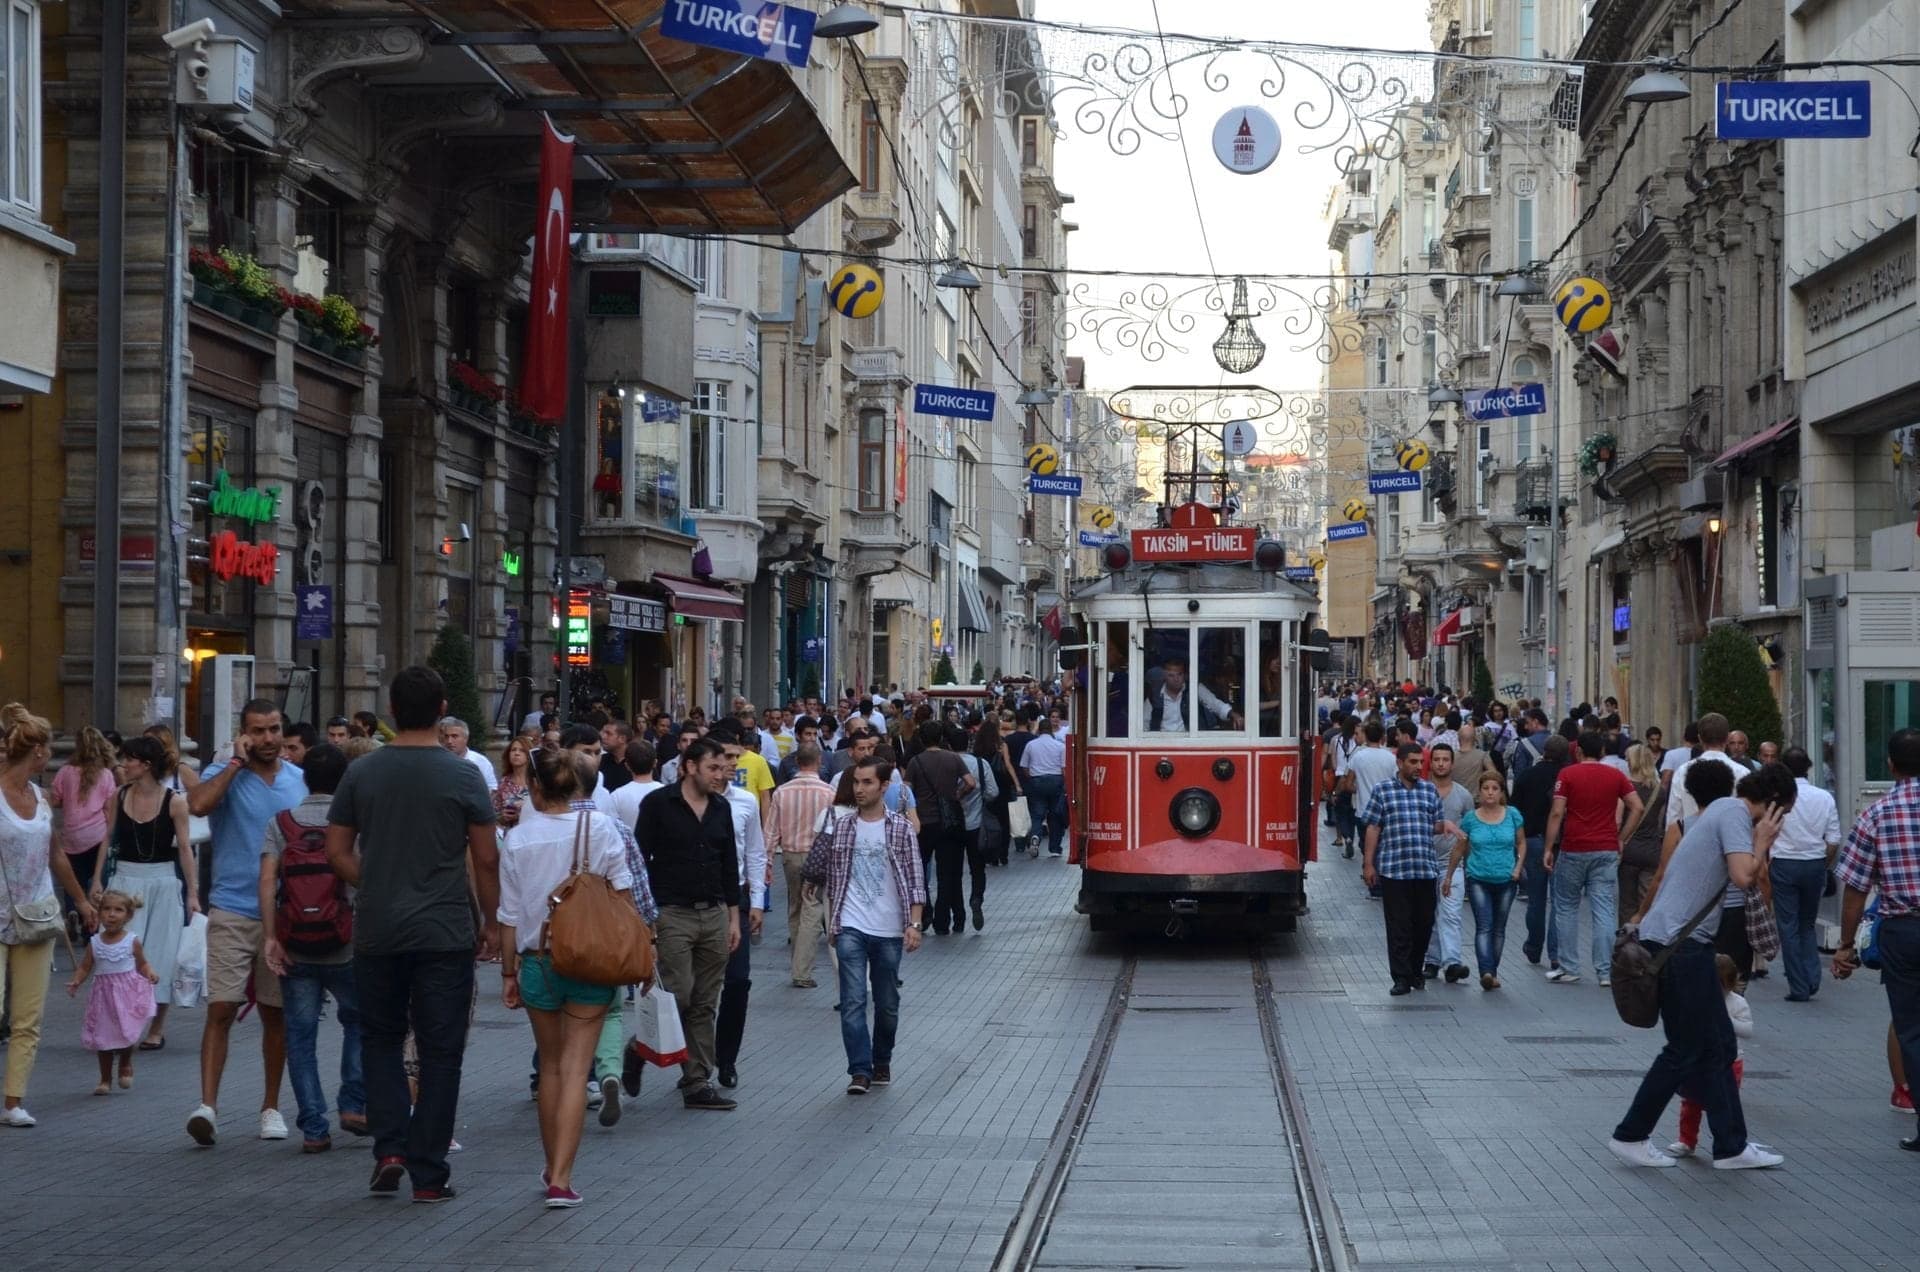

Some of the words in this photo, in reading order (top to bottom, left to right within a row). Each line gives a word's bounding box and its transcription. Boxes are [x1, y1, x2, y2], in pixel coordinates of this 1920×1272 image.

[674, 0, 802, 49] TURKCELL
[1726, 97, 1862, 122] TURKCELL
[919, 392, 990, 413] TURKCELL
[1468, 393, 1541, 413] TURKCELL
[1032, 478, 1080, 492] TURKCELL
[1371, 476, 1419, 488] TURKCELL
[1189, 505, 1196, 526] 1
[1329, 525, 1366, 537] TURKCELL
[1142, 533, 1188, 552] TAKSİM
[1203, 532, 1247, 552] TÜNEL
[1093, 765, 1106, 786] 47
[1280, 765, 1294, 786] 47
